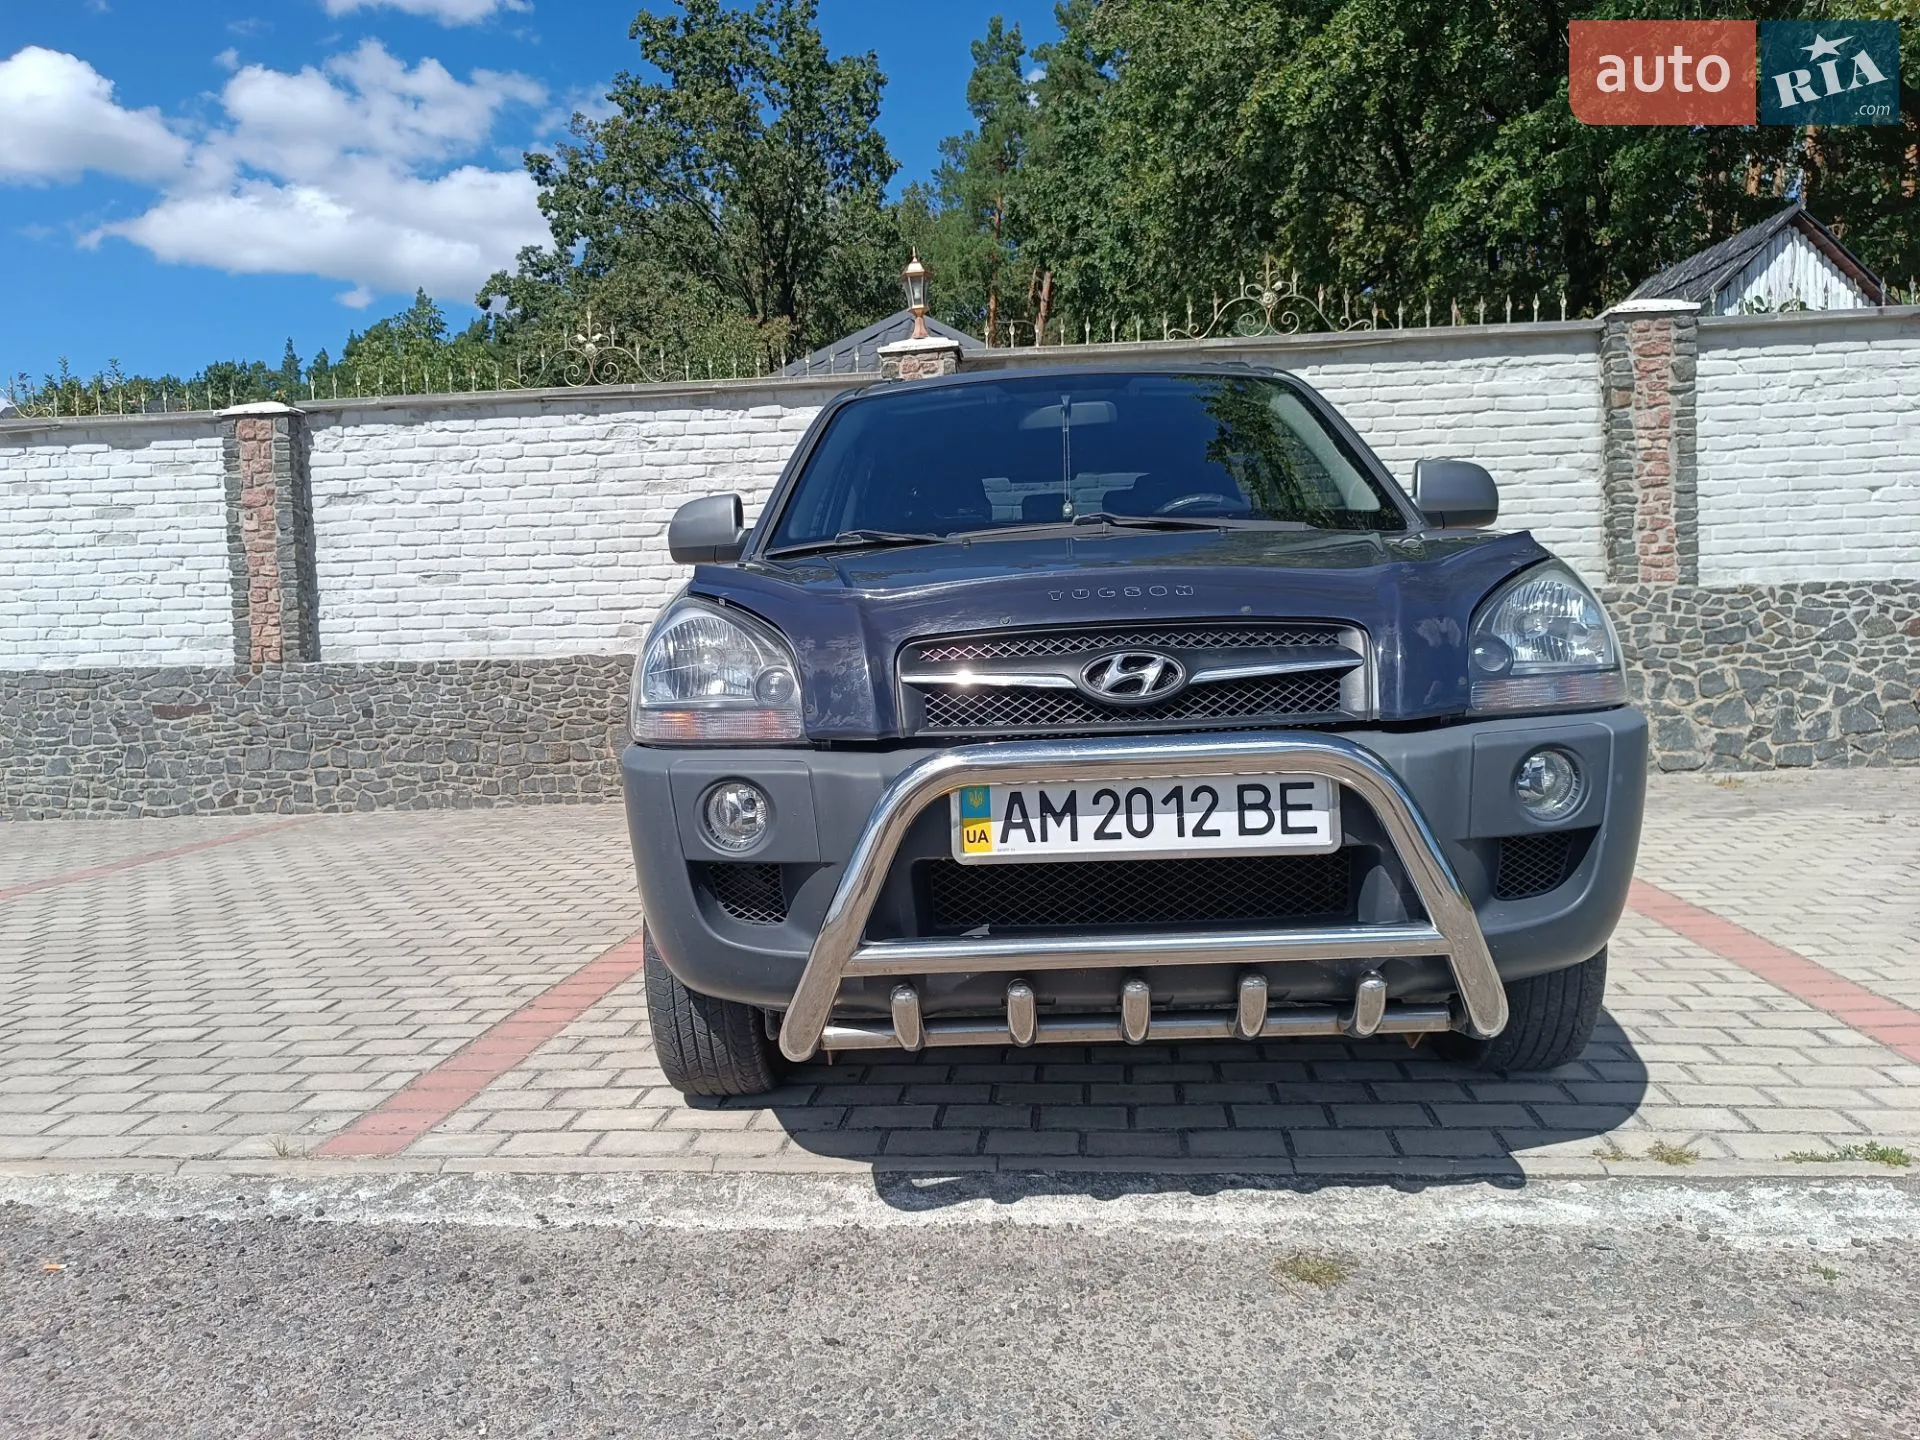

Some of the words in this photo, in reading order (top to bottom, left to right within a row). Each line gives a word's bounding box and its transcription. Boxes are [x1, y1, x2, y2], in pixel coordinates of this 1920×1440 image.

[999, 789, 1078, 843] AM
[1092, 784, 1220, 840] 2012
[1237, 781, 1318, 836] BE
[966, 829, 989, 844] UA
